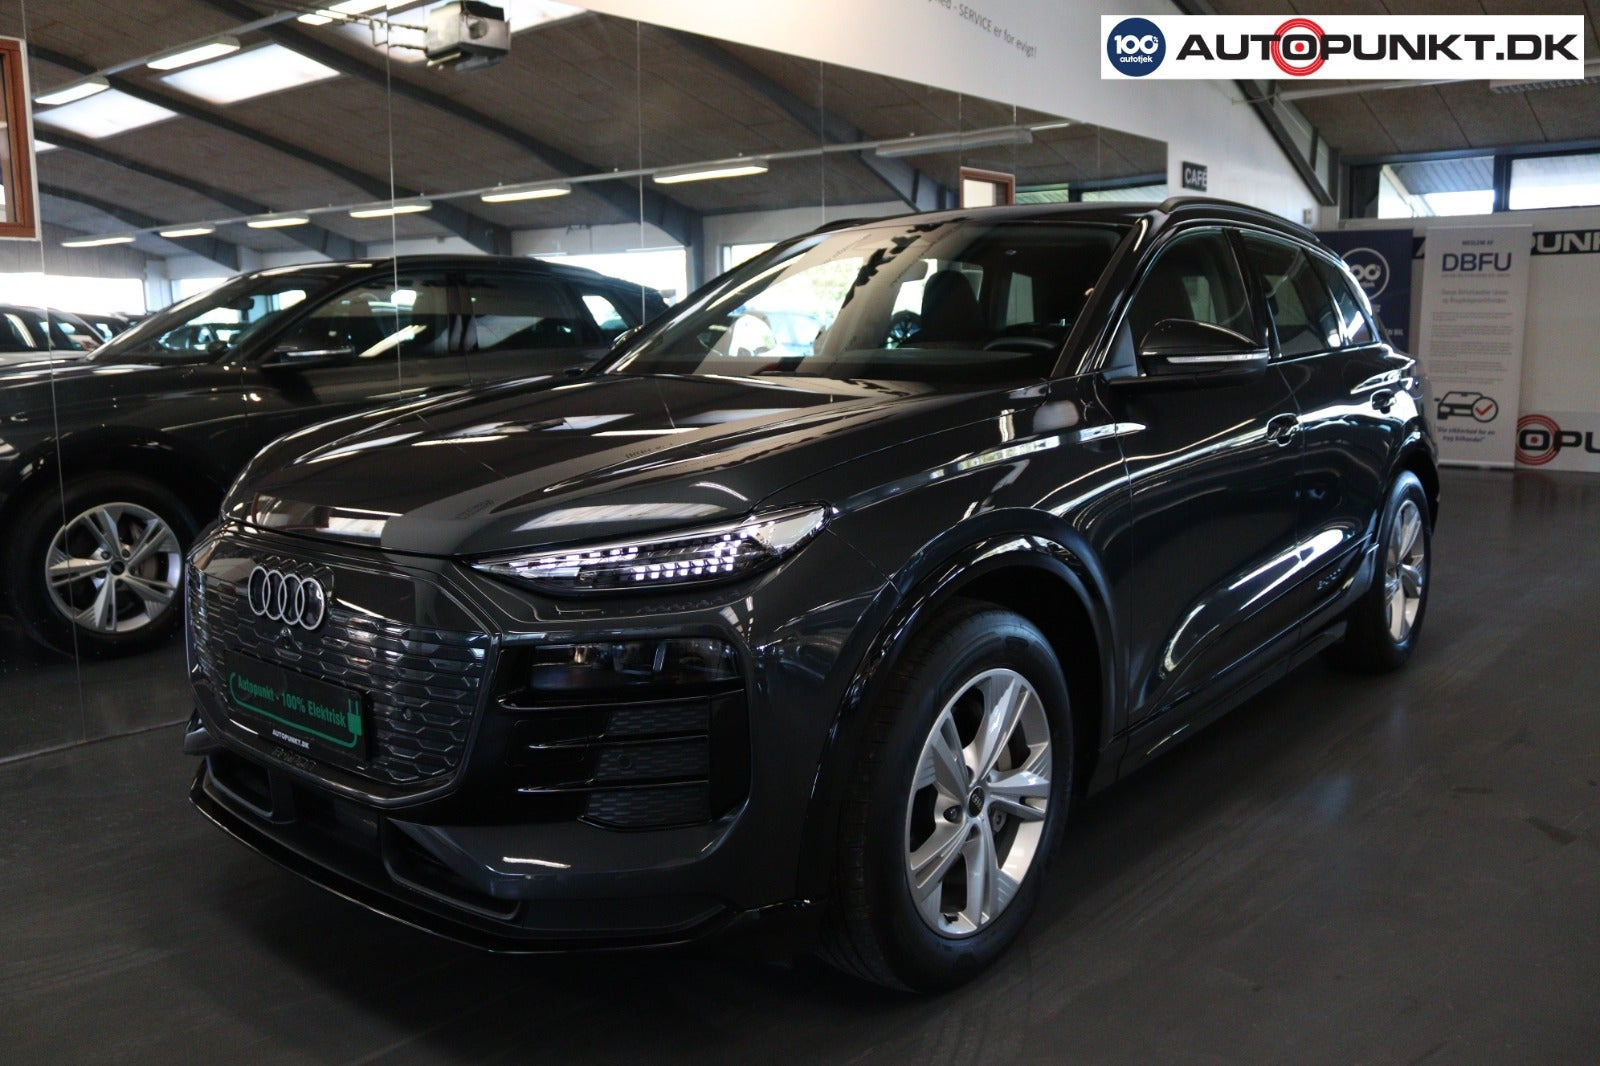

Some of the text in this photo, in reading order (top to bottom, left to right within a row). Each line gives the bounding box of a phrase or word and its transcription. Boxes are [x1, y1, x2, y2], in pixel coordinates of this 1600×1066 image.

[959, 4, 992, 32] SERVICE
[1003, 29, 1015, 45] for
[1442, 252, 1512, 272] DBFU
[238, 674, 274, 701] Autopunkt
[281, 692, 306, 713] 100%
[307, 700, 347, 728] Elektrisk
